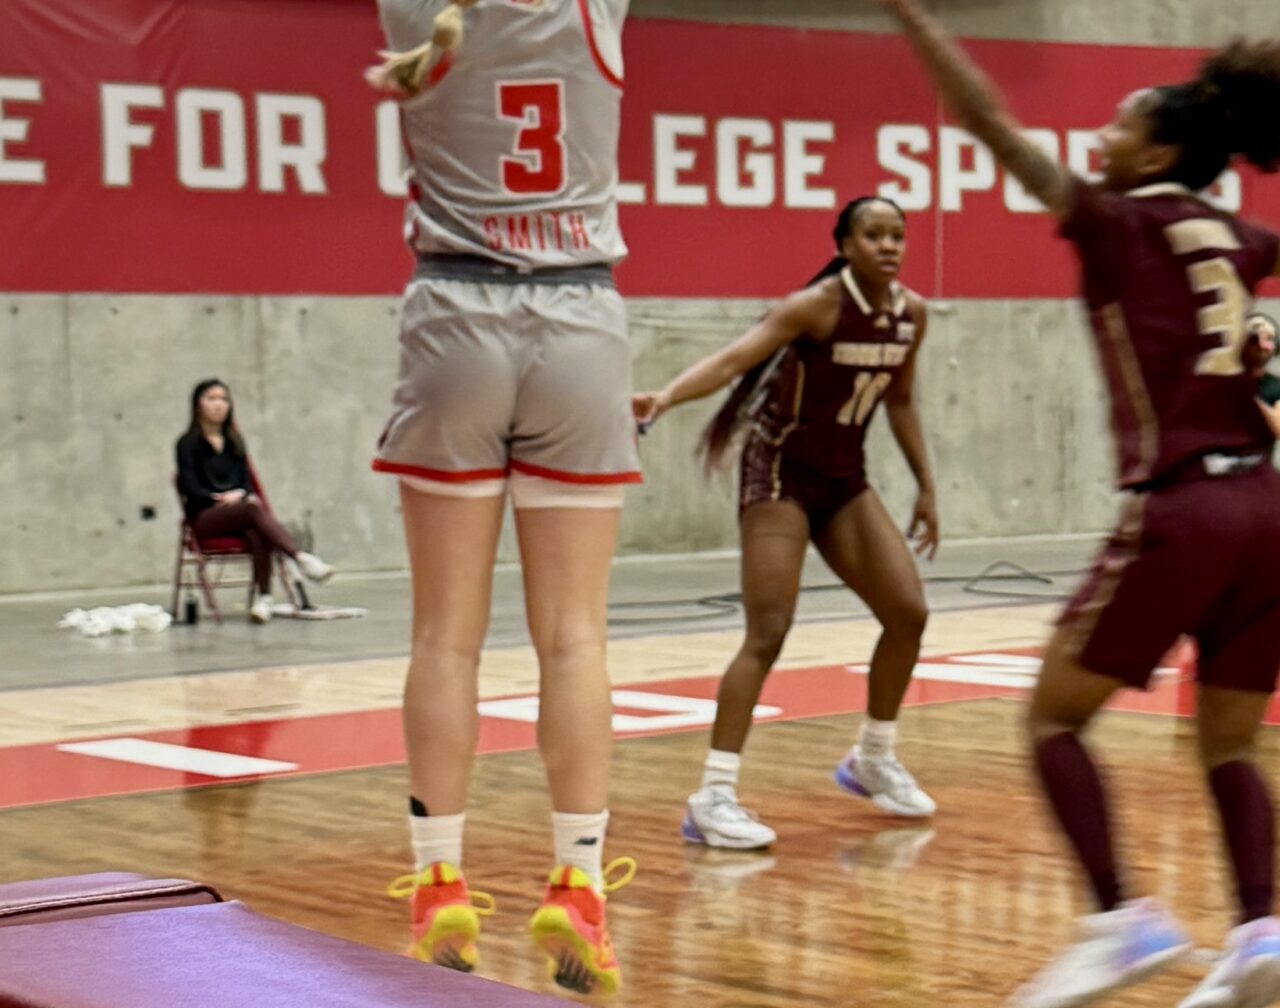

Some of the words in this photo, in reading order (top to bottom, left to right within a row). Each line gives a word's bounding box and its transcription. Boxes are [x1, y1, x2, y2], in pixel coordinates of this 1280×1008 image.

[99, 82, 328, 195] FOR
[496, 78, 566, 195] 3
[484, 211, 590, 252] SMITH
